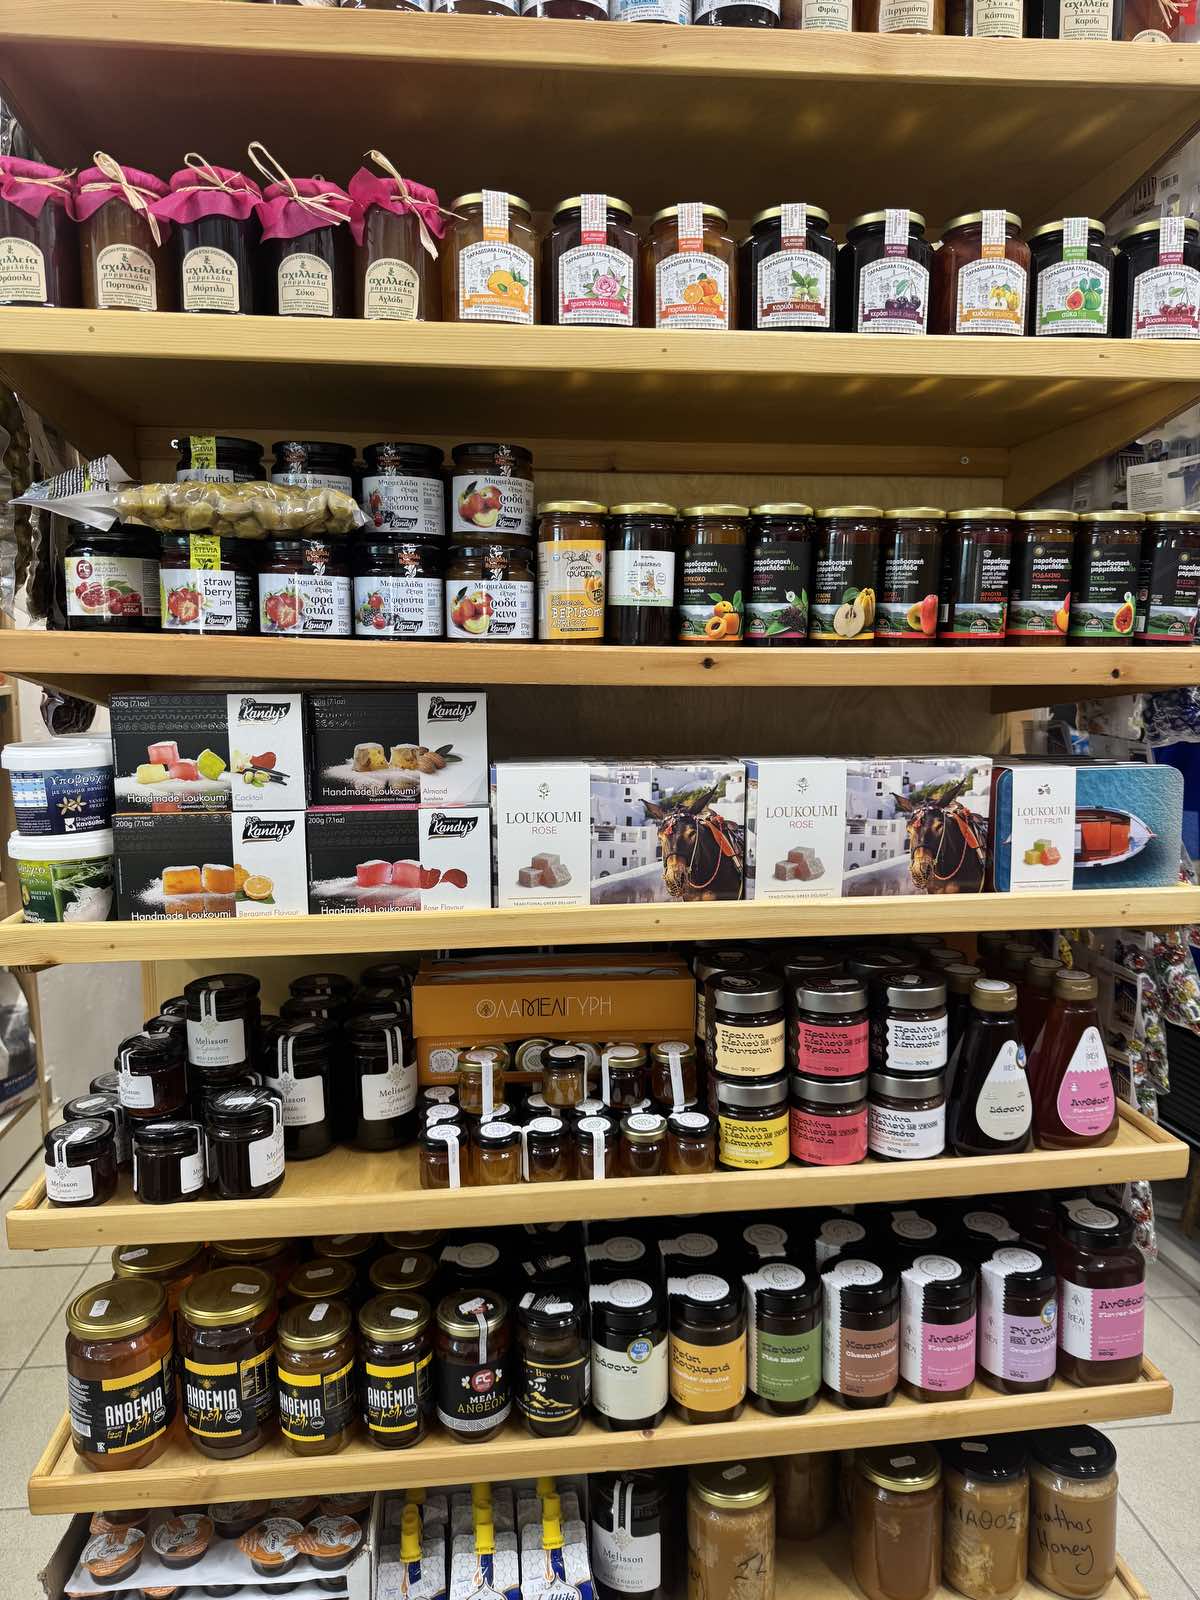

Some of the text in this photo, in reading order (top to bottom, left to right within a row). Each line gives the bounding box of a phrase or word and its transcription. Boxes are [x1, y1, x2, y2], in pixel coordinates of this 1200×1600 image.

[204, 474, 230, 484] fruits
[203, 576, 232, 588] straw
[204, 587, 232, 599] berry
[218, 599, 232, 608] jam
[243, 706, 288, 725] Kandy's
[432, 704, 473, 724] Kandy's
[127, 791, 227, 805] Handmade Loukoumi
[322, 786, 417, 797] Handmade Loukoumi
[506, 811, 583, 825] LOUKOUMI
[765, 804, 839, 819] LOUKOUMI
[1016, 806, 1071, 817] LOUKOUMI
[433, 820, 474, 840] Kandy's
[531, 825, 557, 835] ROSE
[789, 819, 814, 829] ROSE
[247, 824, 292, 843] Kandy's
[131, 910, 231, 922] Handmade Loukoumi
[321, 903, 417, 916] Handmade Loukoumi
[194, 1036, 229, 1048] Melisson
[51, 1179, 79, 1189] Melisson
[457, 1392, 507, 1415] ΑΝΘΕΩΝ
[469, 1391, 496, 1404] ΜΕΛΙ
[602, 1546, 645, 1564] Melisson
[1036, 1527, 1096, 1576] Honey
